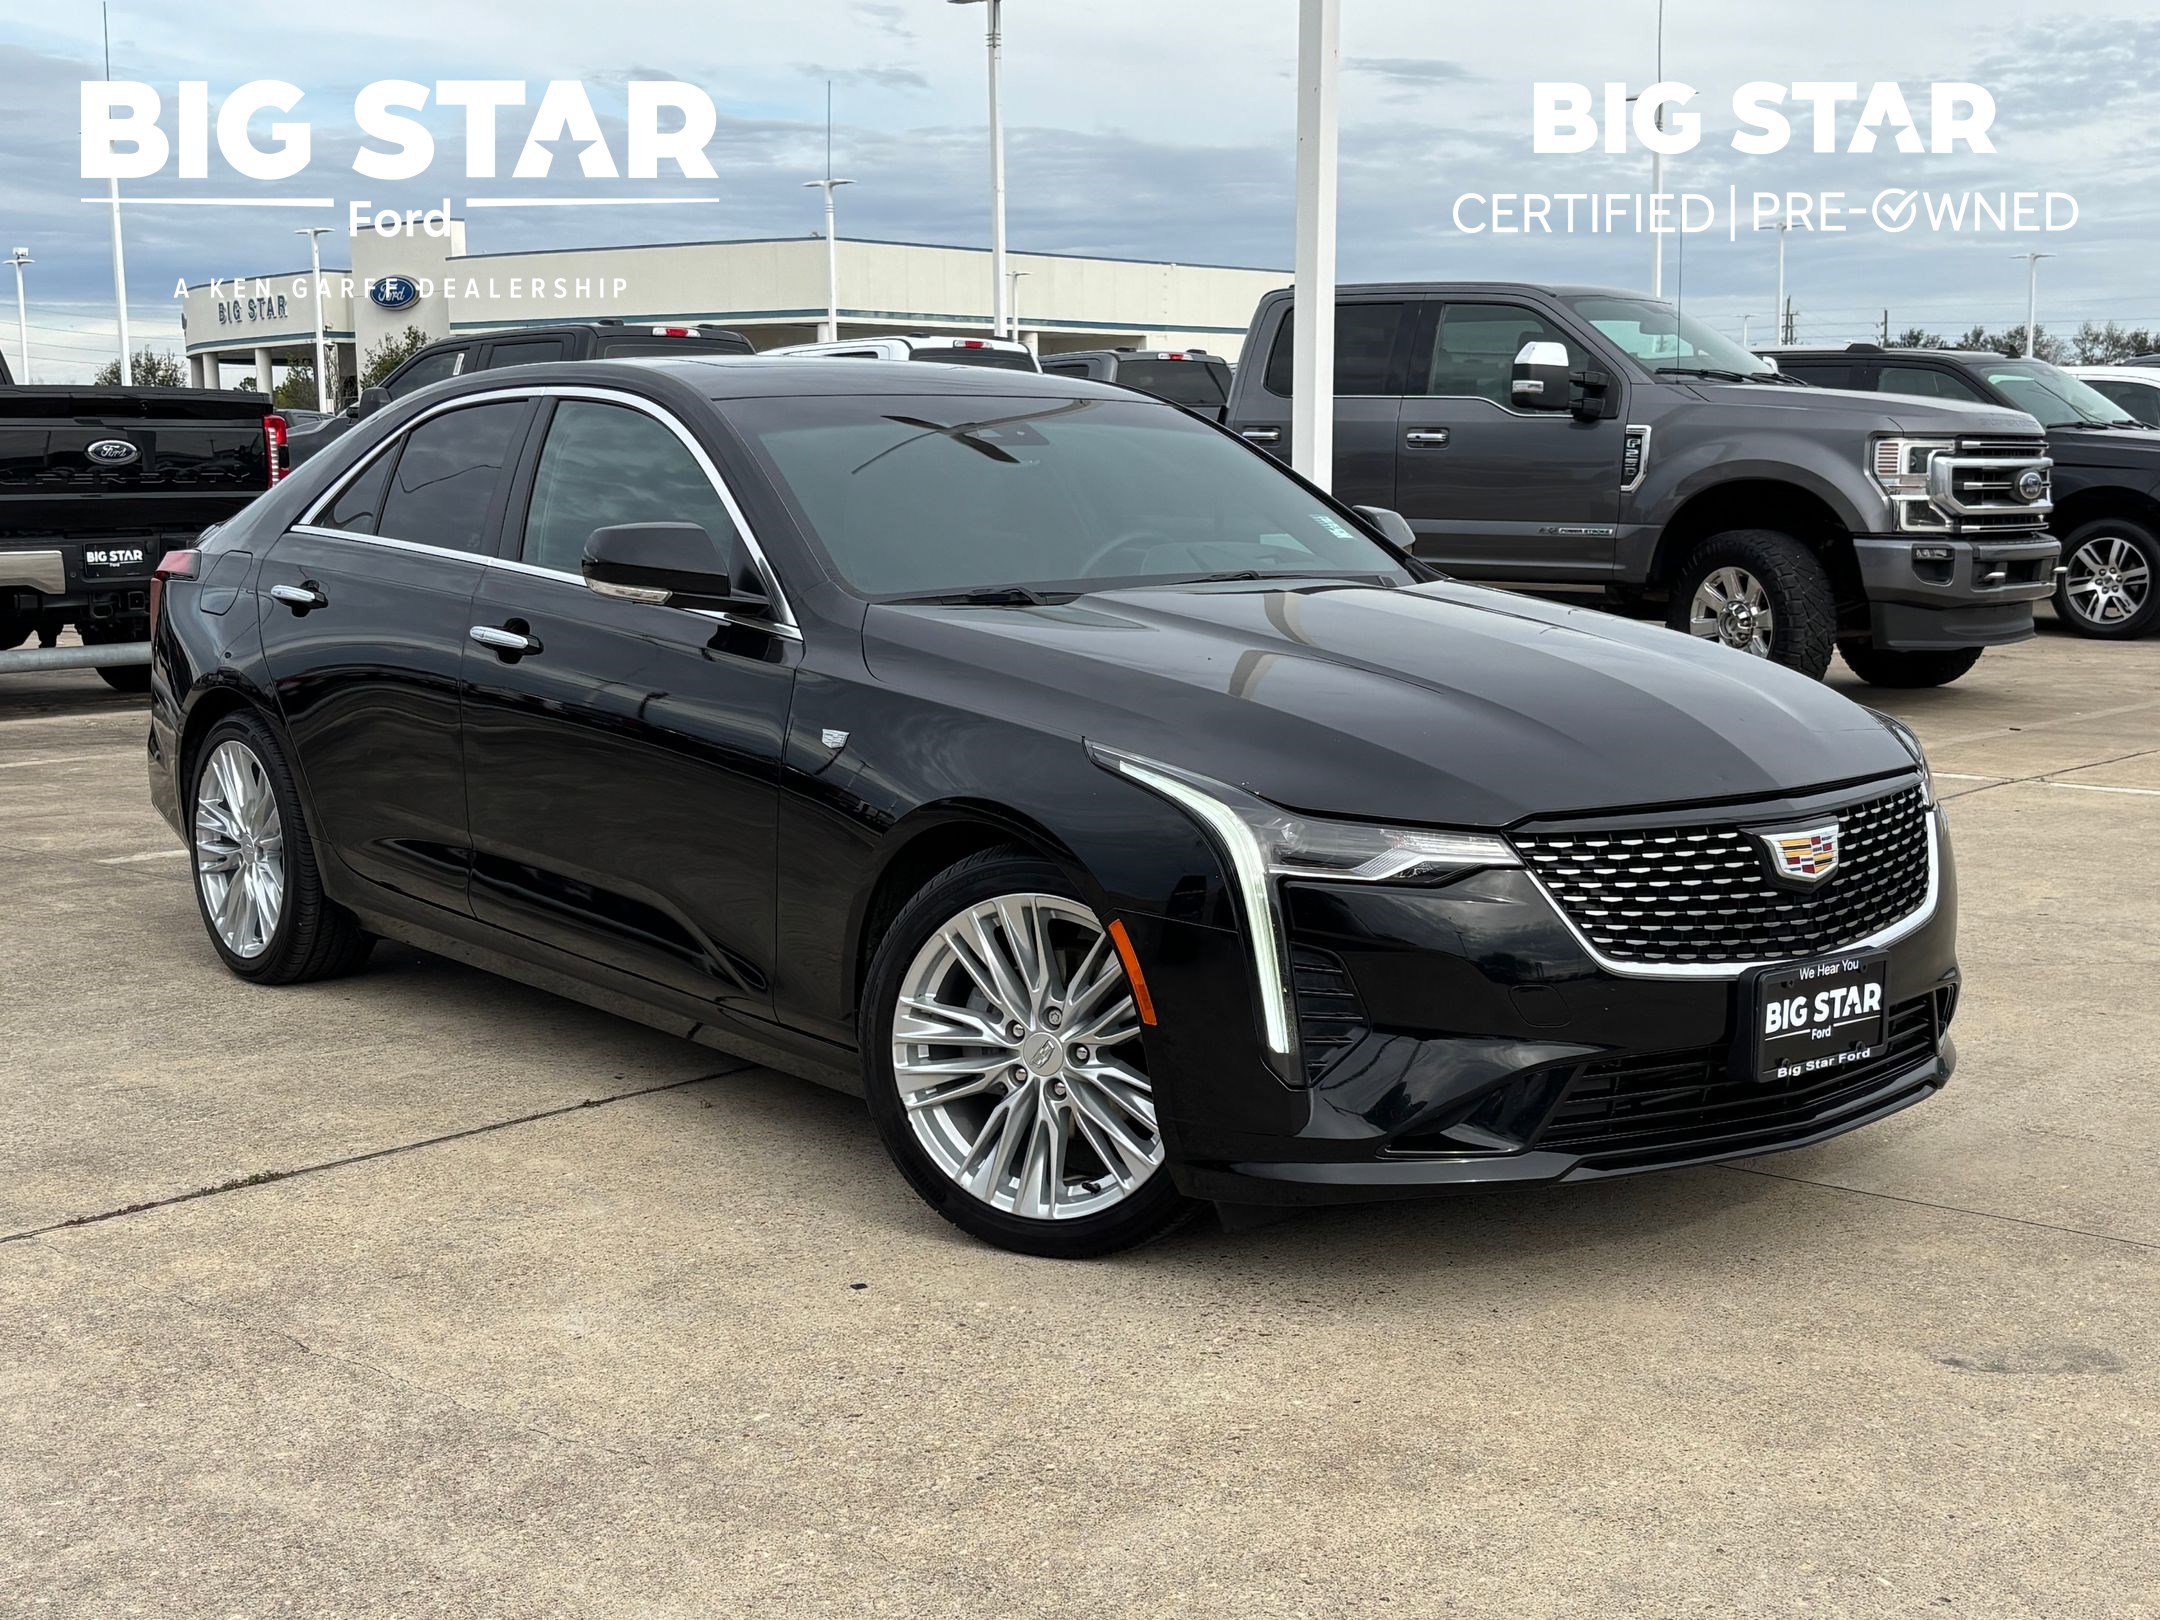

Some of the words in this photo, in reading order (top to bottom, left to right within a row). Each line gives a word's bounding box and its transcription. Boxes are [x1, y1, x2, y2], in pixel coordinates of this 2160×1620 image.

[218, 299, 242, 324] BIG
[248, 295, 288, 321] STAR
[101, 445, 127, 456] Ford
[0, 473, 127, 485] UPER
[139, 472, 250, 484] DUTY
[86, 551, 108, 563] BIG
[109, 549, 143, 562] STAR
[1799, 968, 1814, 980] We
[1817, 963, 1840, 978] Hear
[1842, 959, 1859, 971] You
[1765, 996, 1808, 1034] BIG
[1814, 982, 1882, 1022] STAR
[1811, 1025, 1831, 1040] Ford
[1777, 1065, 1801, 1078] Big
[1806, 1056, 1835, 1072] Star
[1839, 1048, 1871, 1063] Ford
